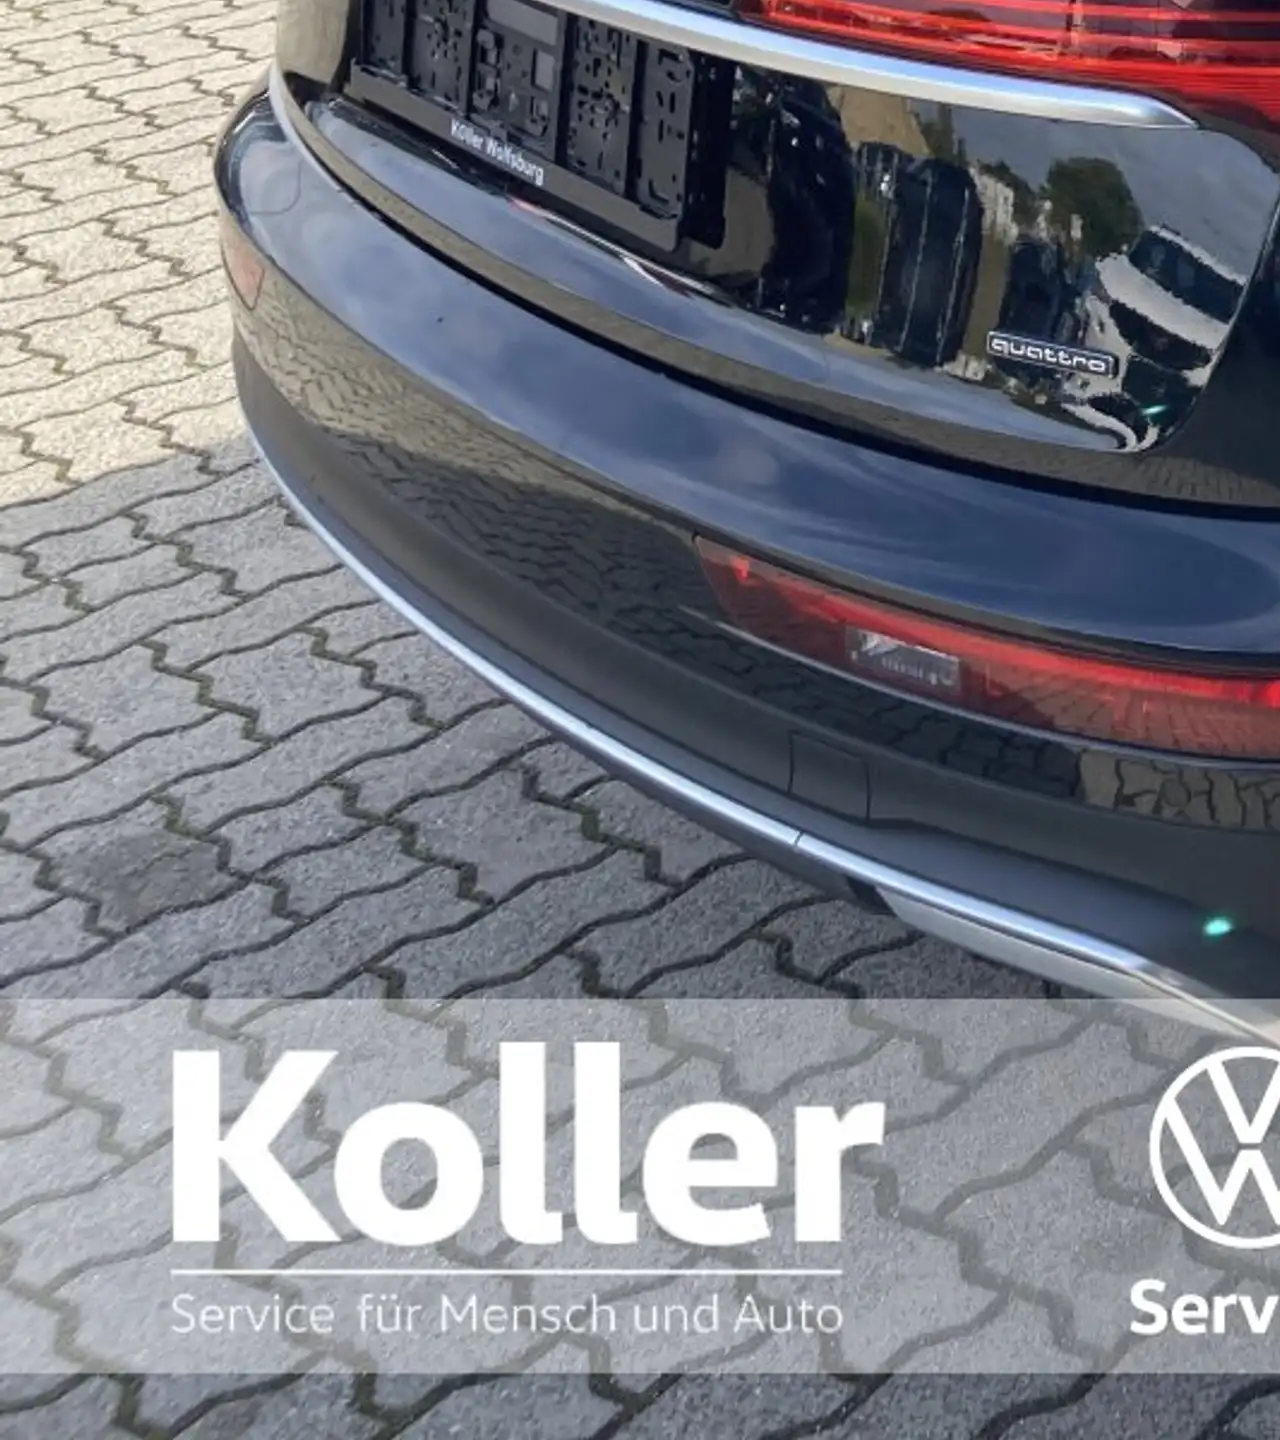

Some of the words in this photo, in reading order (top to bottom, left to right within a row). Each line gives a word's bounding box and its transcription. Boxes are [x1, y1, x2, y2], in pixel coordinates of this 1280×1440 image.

[450, 117, 484, 150] Koller
[485, 135, 545, 187] Wolfsburg
[990, 337, 1106, 373] quattro
